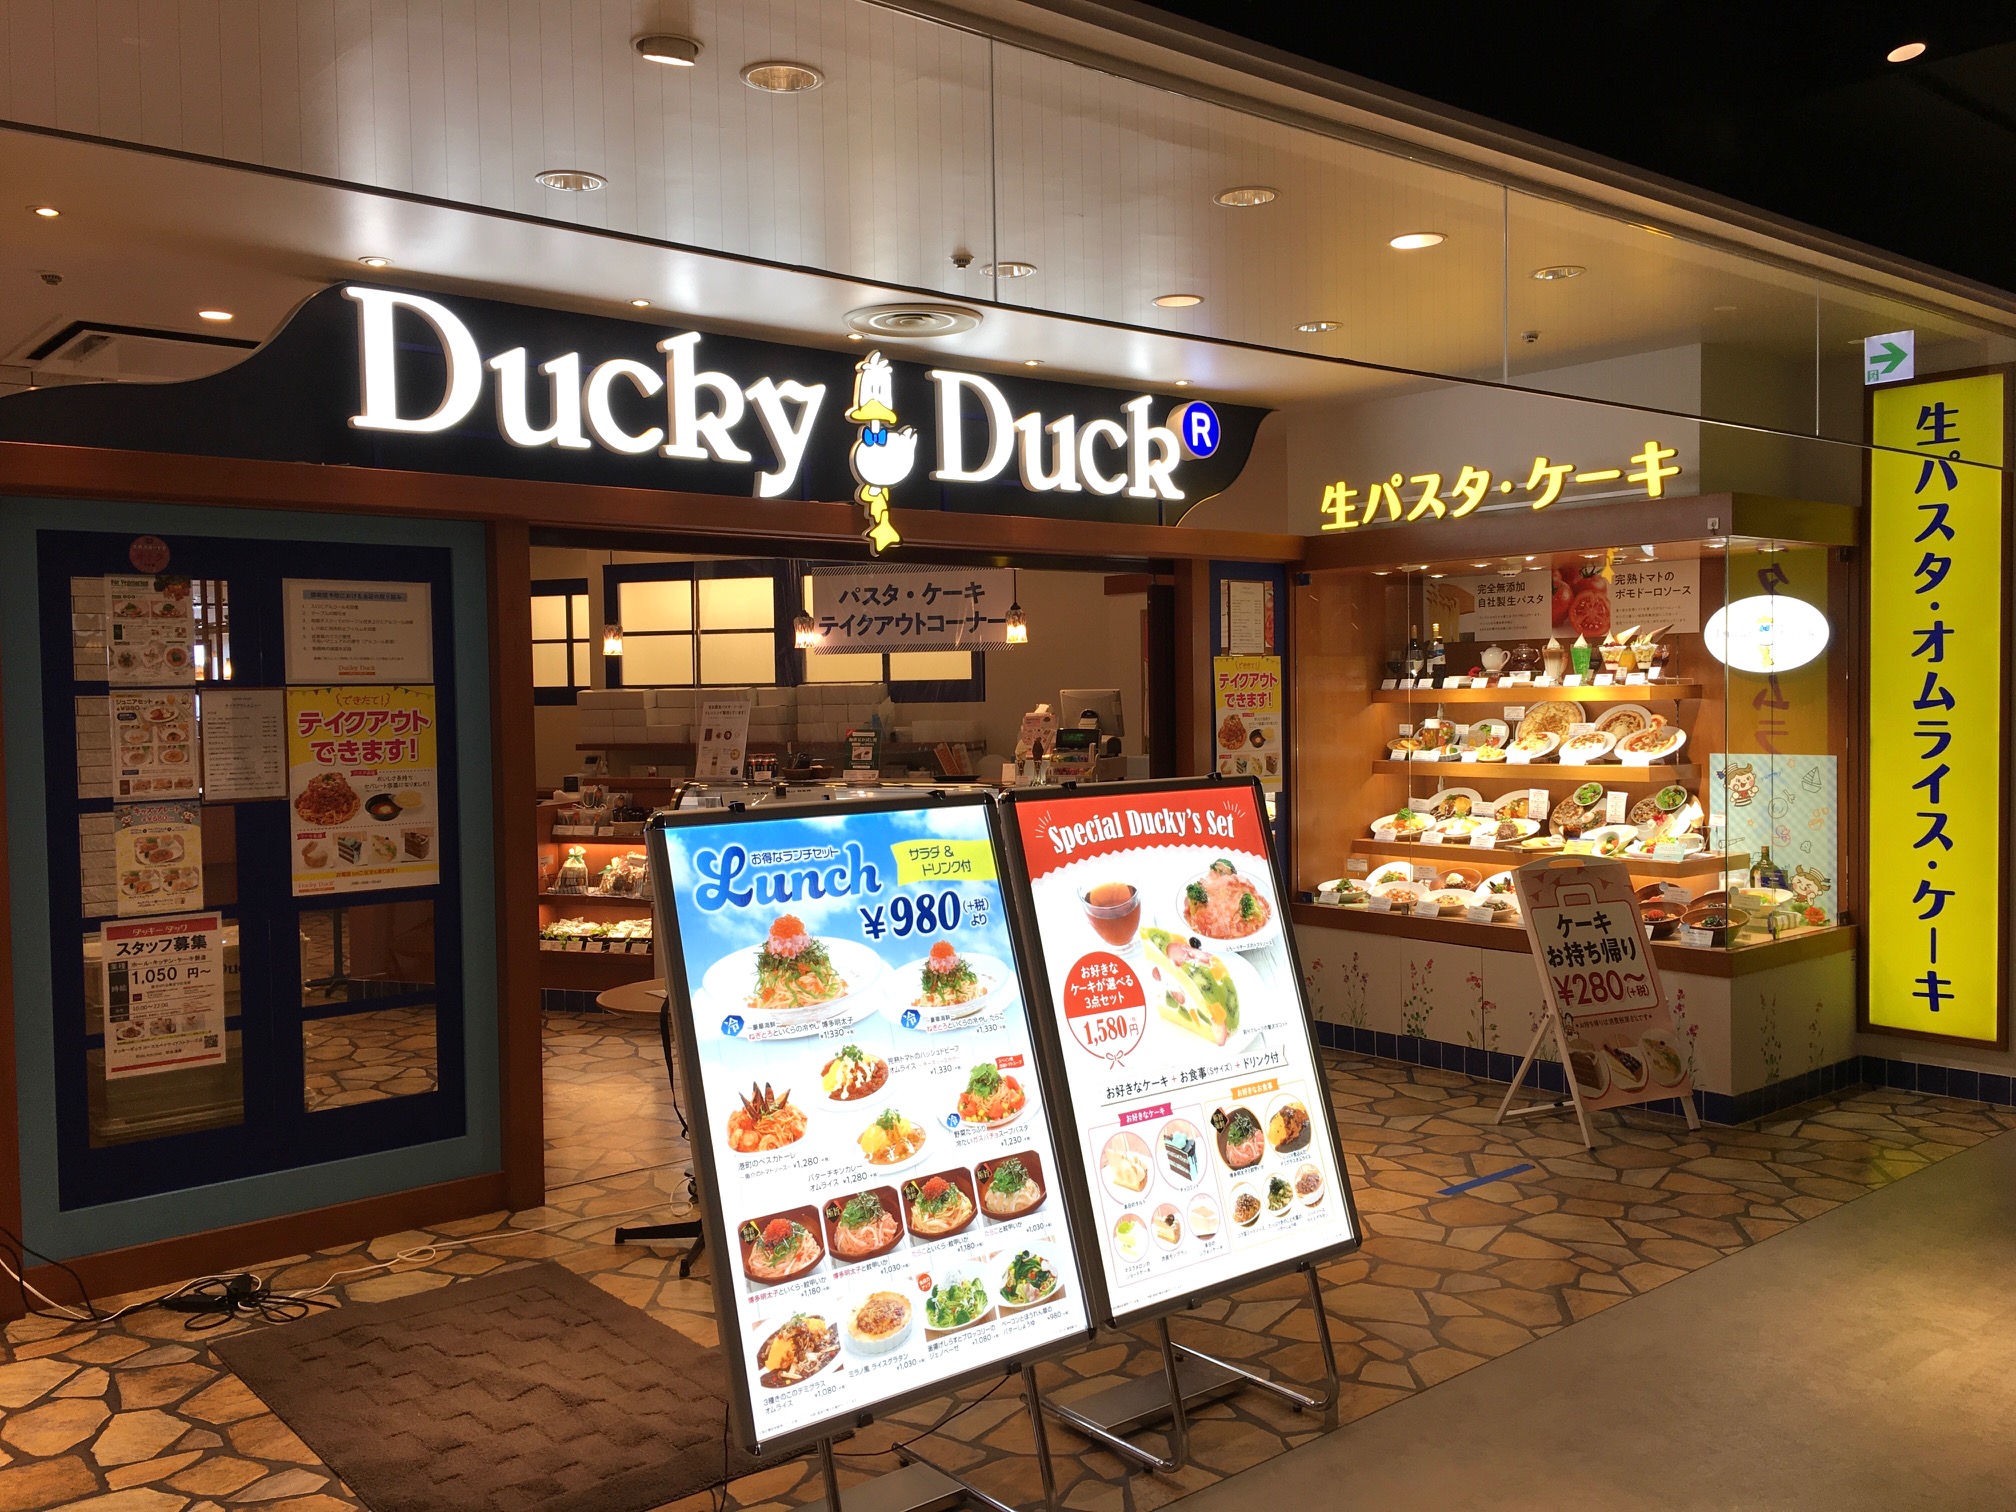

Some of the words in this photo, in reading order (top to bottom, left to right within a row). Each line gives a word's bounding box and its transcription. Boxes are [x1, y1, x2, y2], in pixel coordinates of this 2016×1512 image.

[343, 286, 826, 498] Ducky
[925, 370, 1185, 500] Duck
[1320, 439, 1682, 531] 生パスタ・ケーキ
[1615, 571, 1675, 586] 完熟トマトの
[838, 581, 986, 607] パスタ・ケーキ
[1477, 581, 1526, 595] 完全無添加
[1615, 585, 1692, 600] ポモドーロソース
[1477, 594, 1544, 608] 自社製生パスタ
[818, 611, 1006, 637] テイクアウトコーナー
[1219, 672, 1278, 691] テイクアウト
[1224, 691, 1273, 708] できます！
[1910, 401, 1961, 1012] 生パスタ・オムライス・ケーキ
[299, 710, 429, 735] テイクアウト
[311, 738, 416, 763] できます！
[1048, 811, 1124, 854] Special
[1126, 807, 1202, 837] Ducky's
[1205, 810, 1235, 838] Set
[751, 846, 839, 865] お得なランチセット
[909, 845, 939, 861] サラダ
[944, 846, 954, 857] &
[922, 860, 971, 876] ドリンク付
[696, 844, 881, 911] Lunch
[859, 891, 960, 939] ¥980
[970, 913, 987, 926] より
[1557, 911, 1612, 938] ケーキ
[116, 934, 208, 956] スタッフ募集
[1547, 936, 1636, 968] お持ち帰り
[132, 967, 177, 985] 1,050
[1081, 962, 1118, 979] お好きな
[1070, 975, 1134, 996] ケーキが選べる
[1085, 992, 1125, 1009] 3点セット
[724, 1017, 739, 1034] 冷
[1084, 1014, 1128, 1046] 1,580
[1129, 1023, 1139, 1036] 円
[889, 1062, 917, 1074] オムライス
[1106, 1076, 1168, 1100] お好きなケーキ
[1243, 1051, 1279, 1070] ドリンク付
[1237, 1082, 1273, 1097] お好きなお食事
[1125, 1107, 1166, 1123] お好きなケーキ
[953, 1125, 987, 1138] 野菜たっぷり
[956, 1124, 1029, 1147] 冷たいガスパチョスープパスタ
[808, 1164, 863, 1182] バターチキンカレー
[809, 1178, 839, 1192] オムライス
[765, 1399, 794, 1415] オムライス
